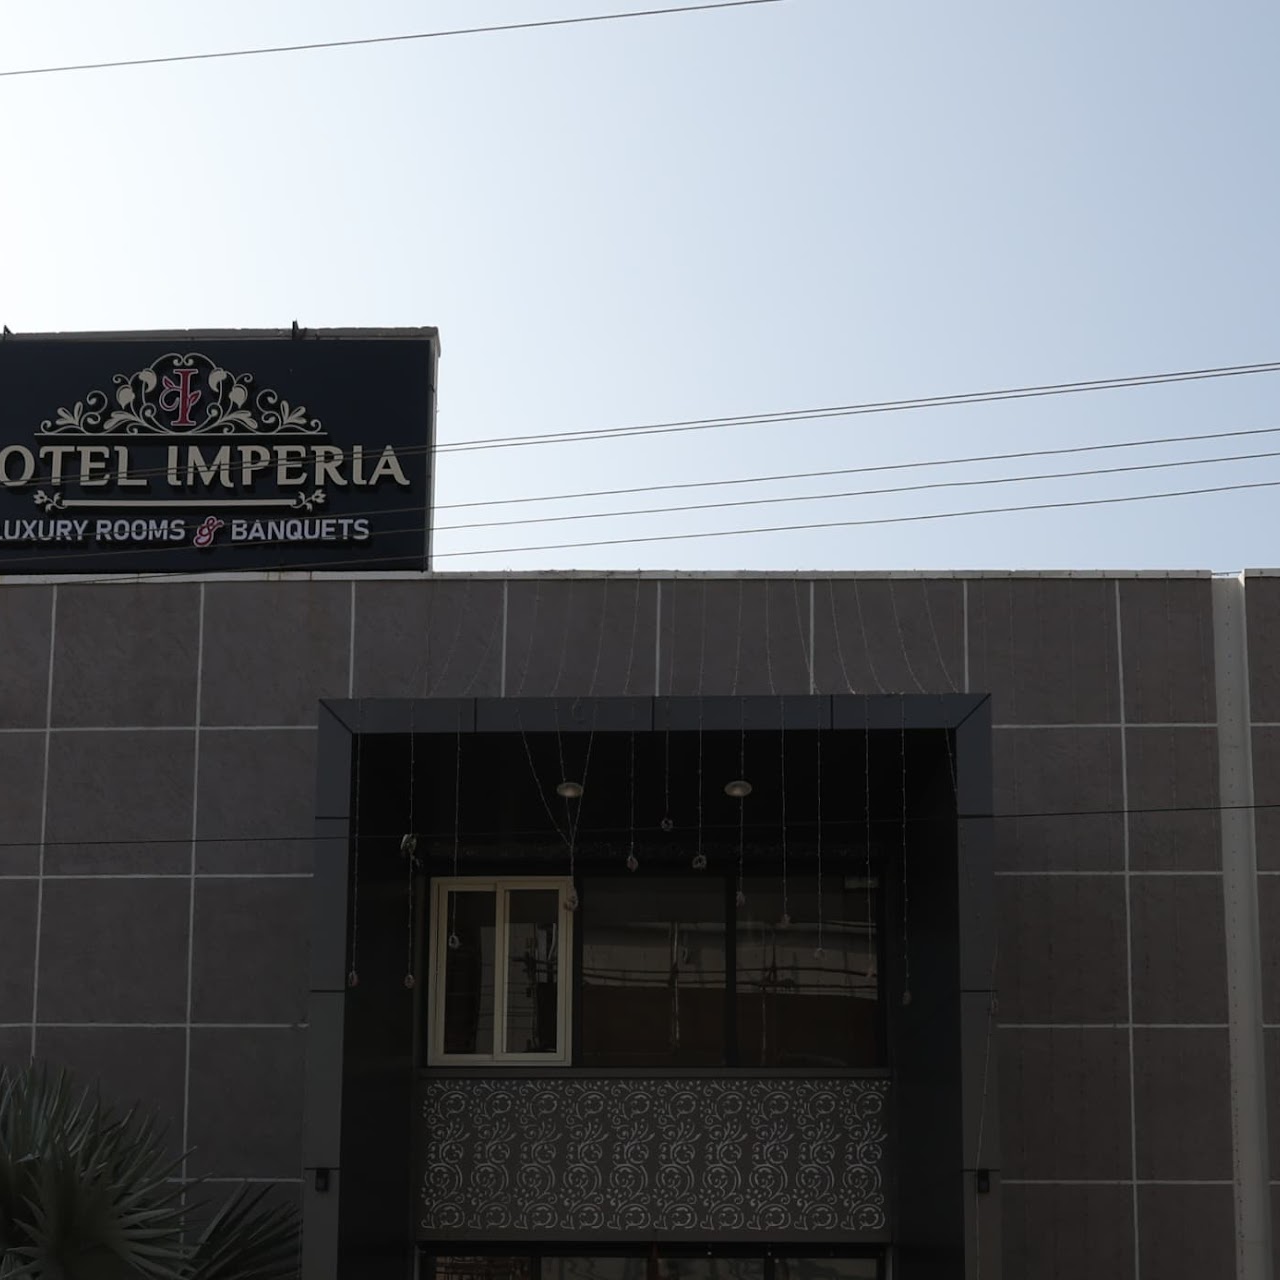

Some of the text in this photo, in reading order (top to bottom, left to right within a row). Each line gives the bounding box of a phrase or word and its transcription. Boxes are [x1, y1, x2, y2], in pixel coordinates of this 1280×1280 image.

[166, 443, 411, 487] IMPERIA
[95, 518, 186, 541] ROOMS
[231, 518, 370, 541] BANQUETS
